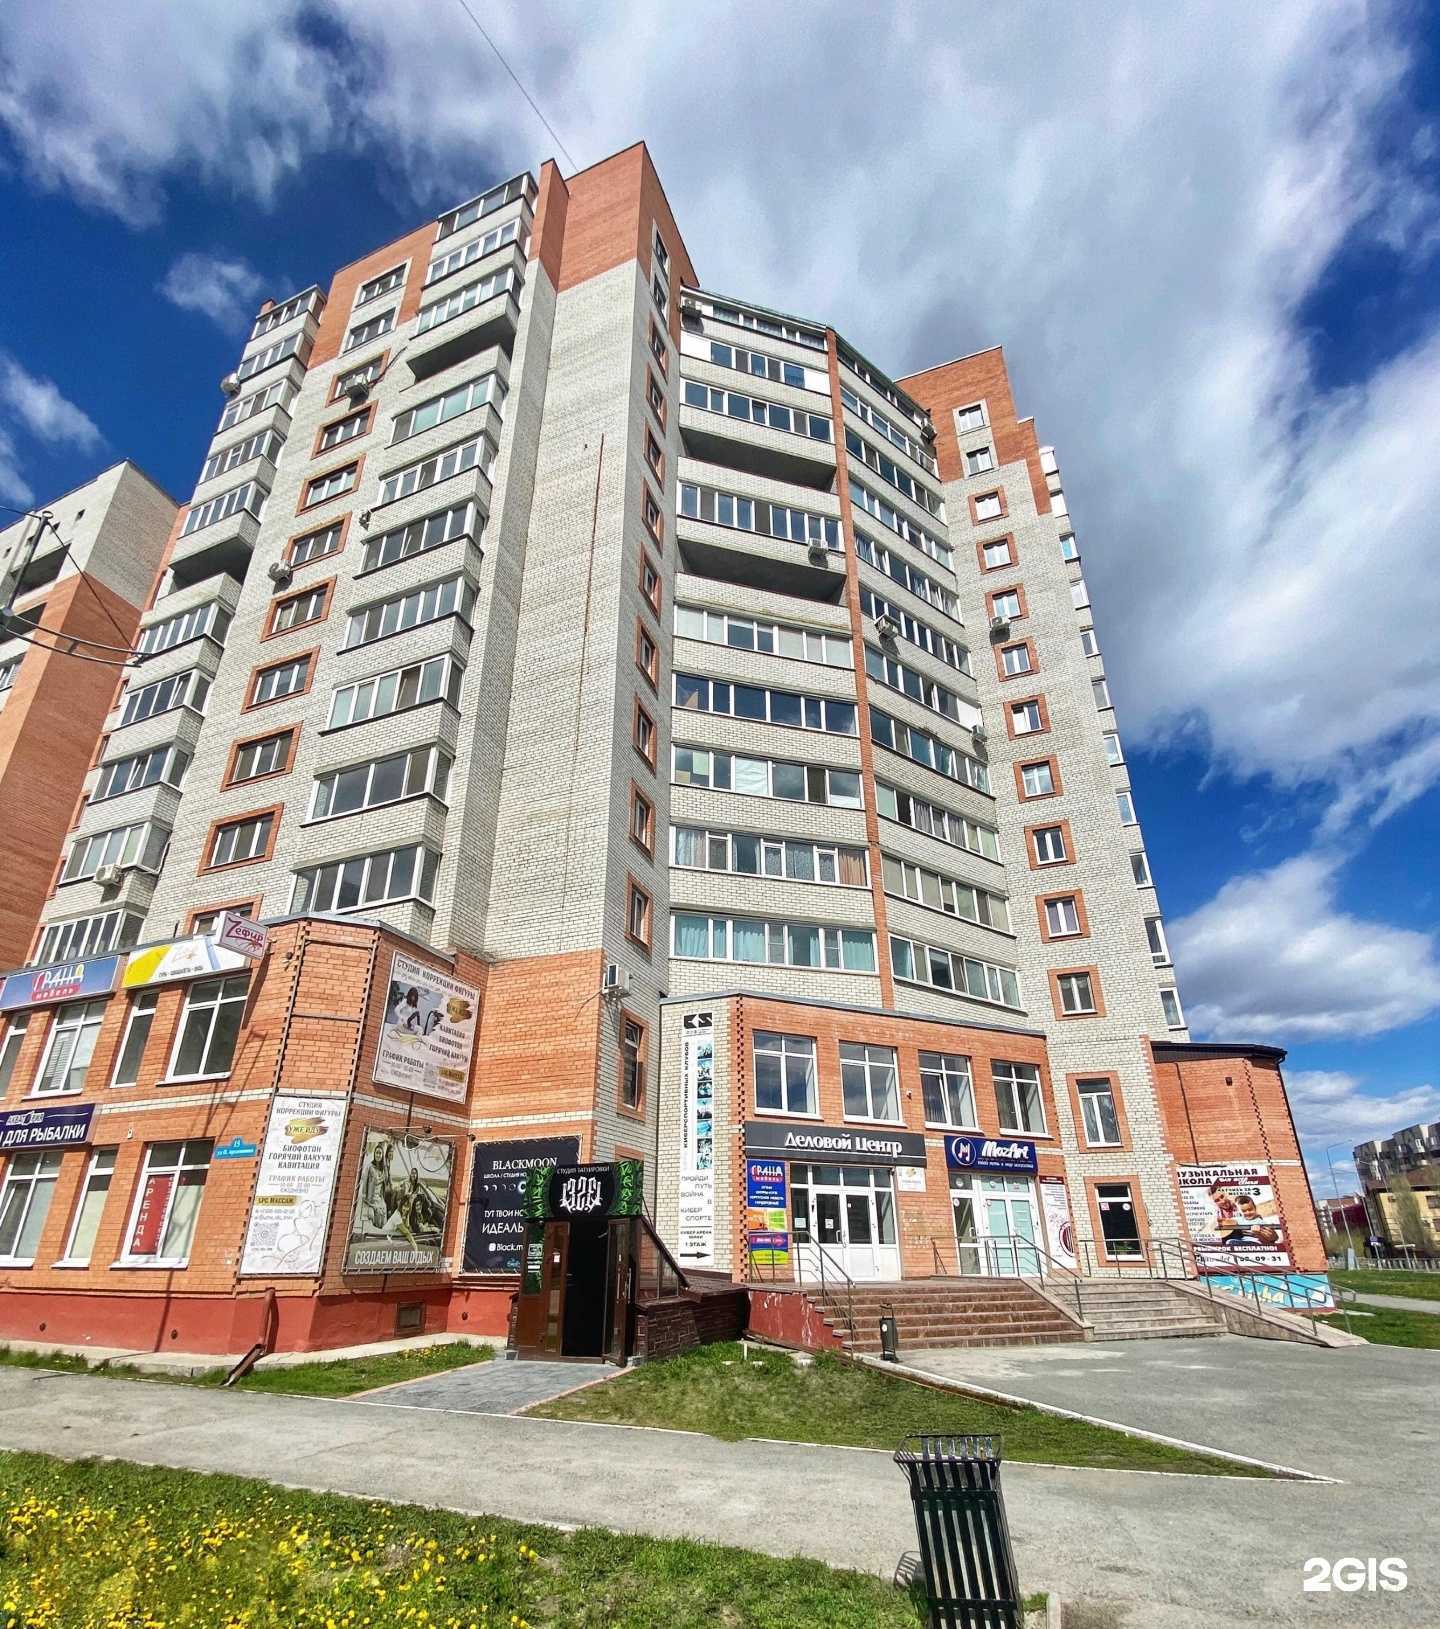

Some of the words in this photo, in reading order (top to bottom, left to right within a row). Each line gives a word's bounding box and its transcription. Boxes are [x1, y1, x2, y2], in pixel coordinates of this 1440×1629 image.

[422, 971, 454, 992] КОРРЕКЦИИ
[454, 986, 476, 1000] ФИГУРЫ
[2, 1128, 28, 1147] ДЛЯ
[29, 1124, 86, 1142] РЫБАЛКИ
[282, 1144, 322, 1152] БИОФОТОН
[784, 1132, 852, 1150] Деловой
[855, 1136, 902, 1158] Центр
[492, 1157, 558, 1170] BLACKMOON
[496, 1210, 514, 1218] ТВОИ
[482, 1222, 524, 1234] ИДЕАЛЬ
[354, 1250, 392, 1264] СОЗДАЕМ
[392, 1251, 410, 1264] ВАШ
[410, 1252, 434, 1264] ОТДЫХ
